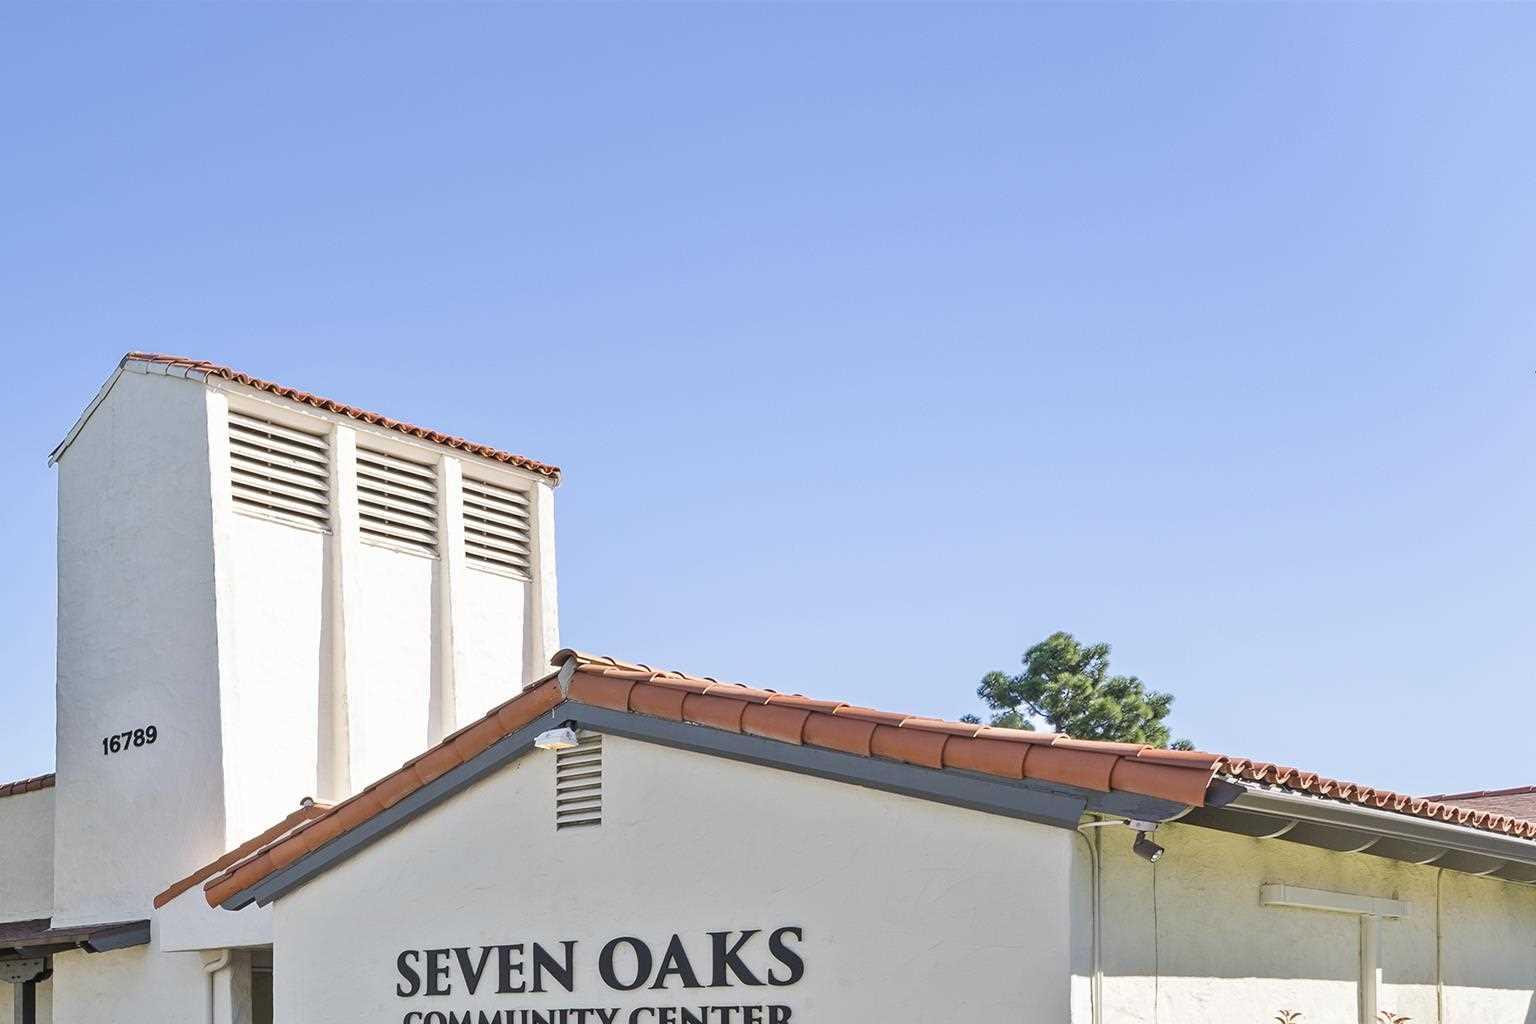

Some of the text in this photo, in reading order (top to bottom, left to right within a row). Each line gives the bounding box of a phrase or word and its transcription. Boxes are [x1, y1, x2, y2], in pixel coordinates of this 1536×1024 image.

[102, 725, 158, 755] 16789
[396, 926, 805, 998] SEVEN OAKS
